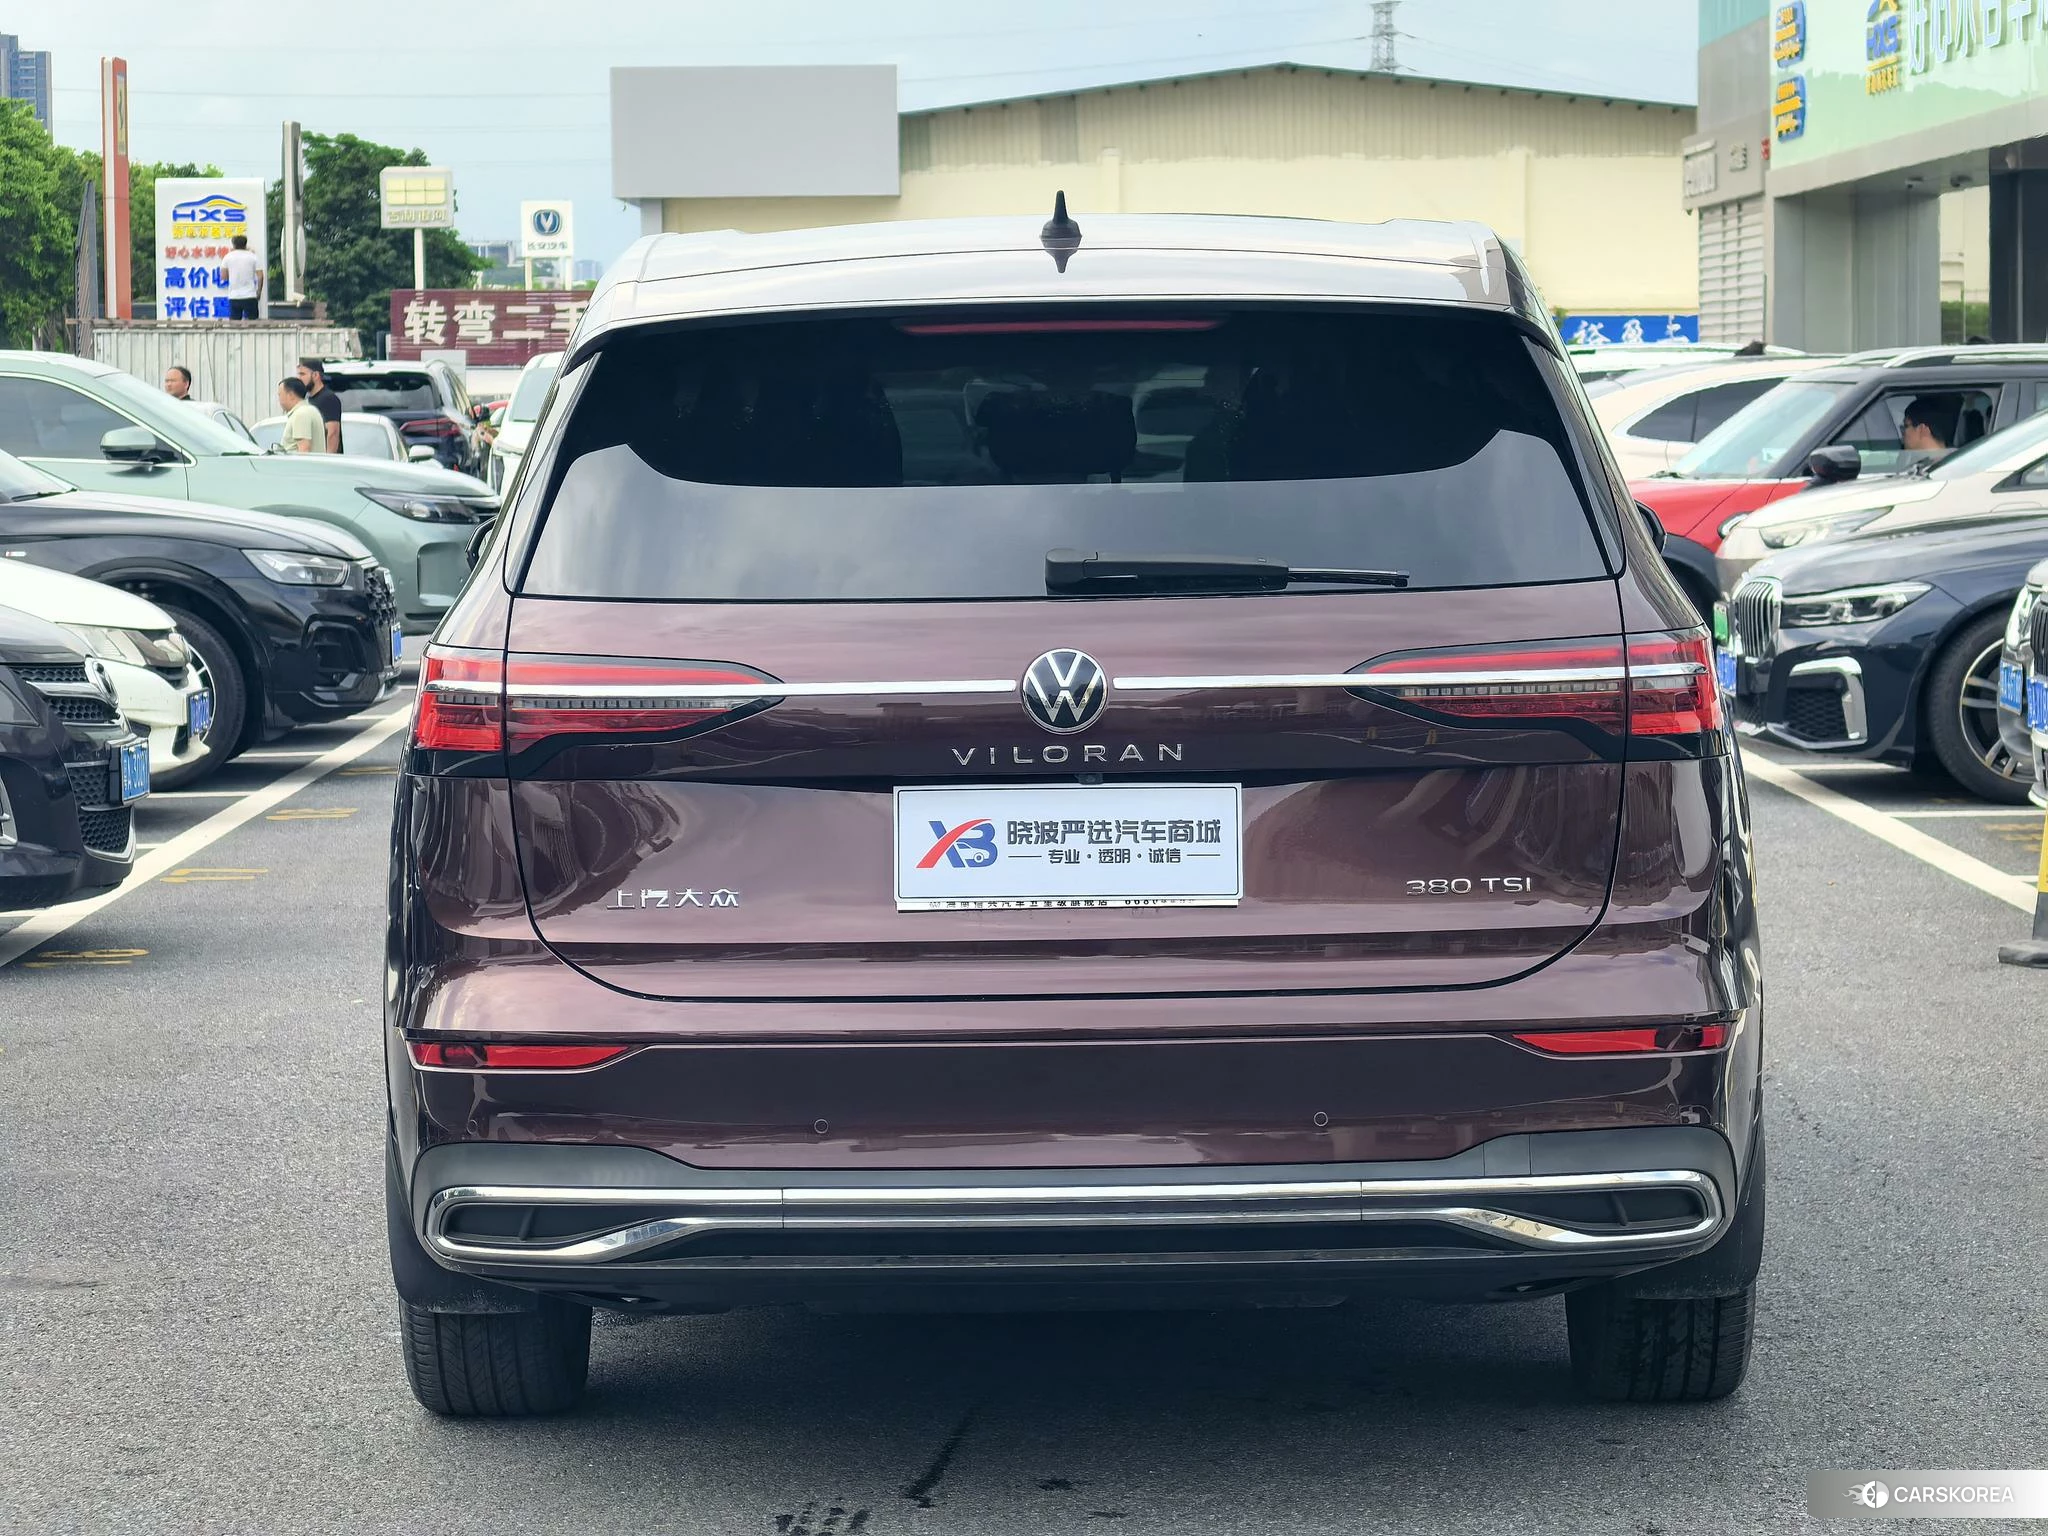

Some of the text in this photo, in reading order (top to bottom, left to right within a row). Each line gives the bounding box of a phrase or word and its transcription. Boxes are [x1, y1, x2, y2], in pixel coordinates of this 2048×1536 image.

[172, 208, 246, 222] HXS
[951, 743, 1184, 766] VILORAN
[1007, 819, 1222, 846] 晓波严选汽车商城
[1406, 876, 1532, 895] 380 TSI
[606, 888, 740, 909] 上汽大众
